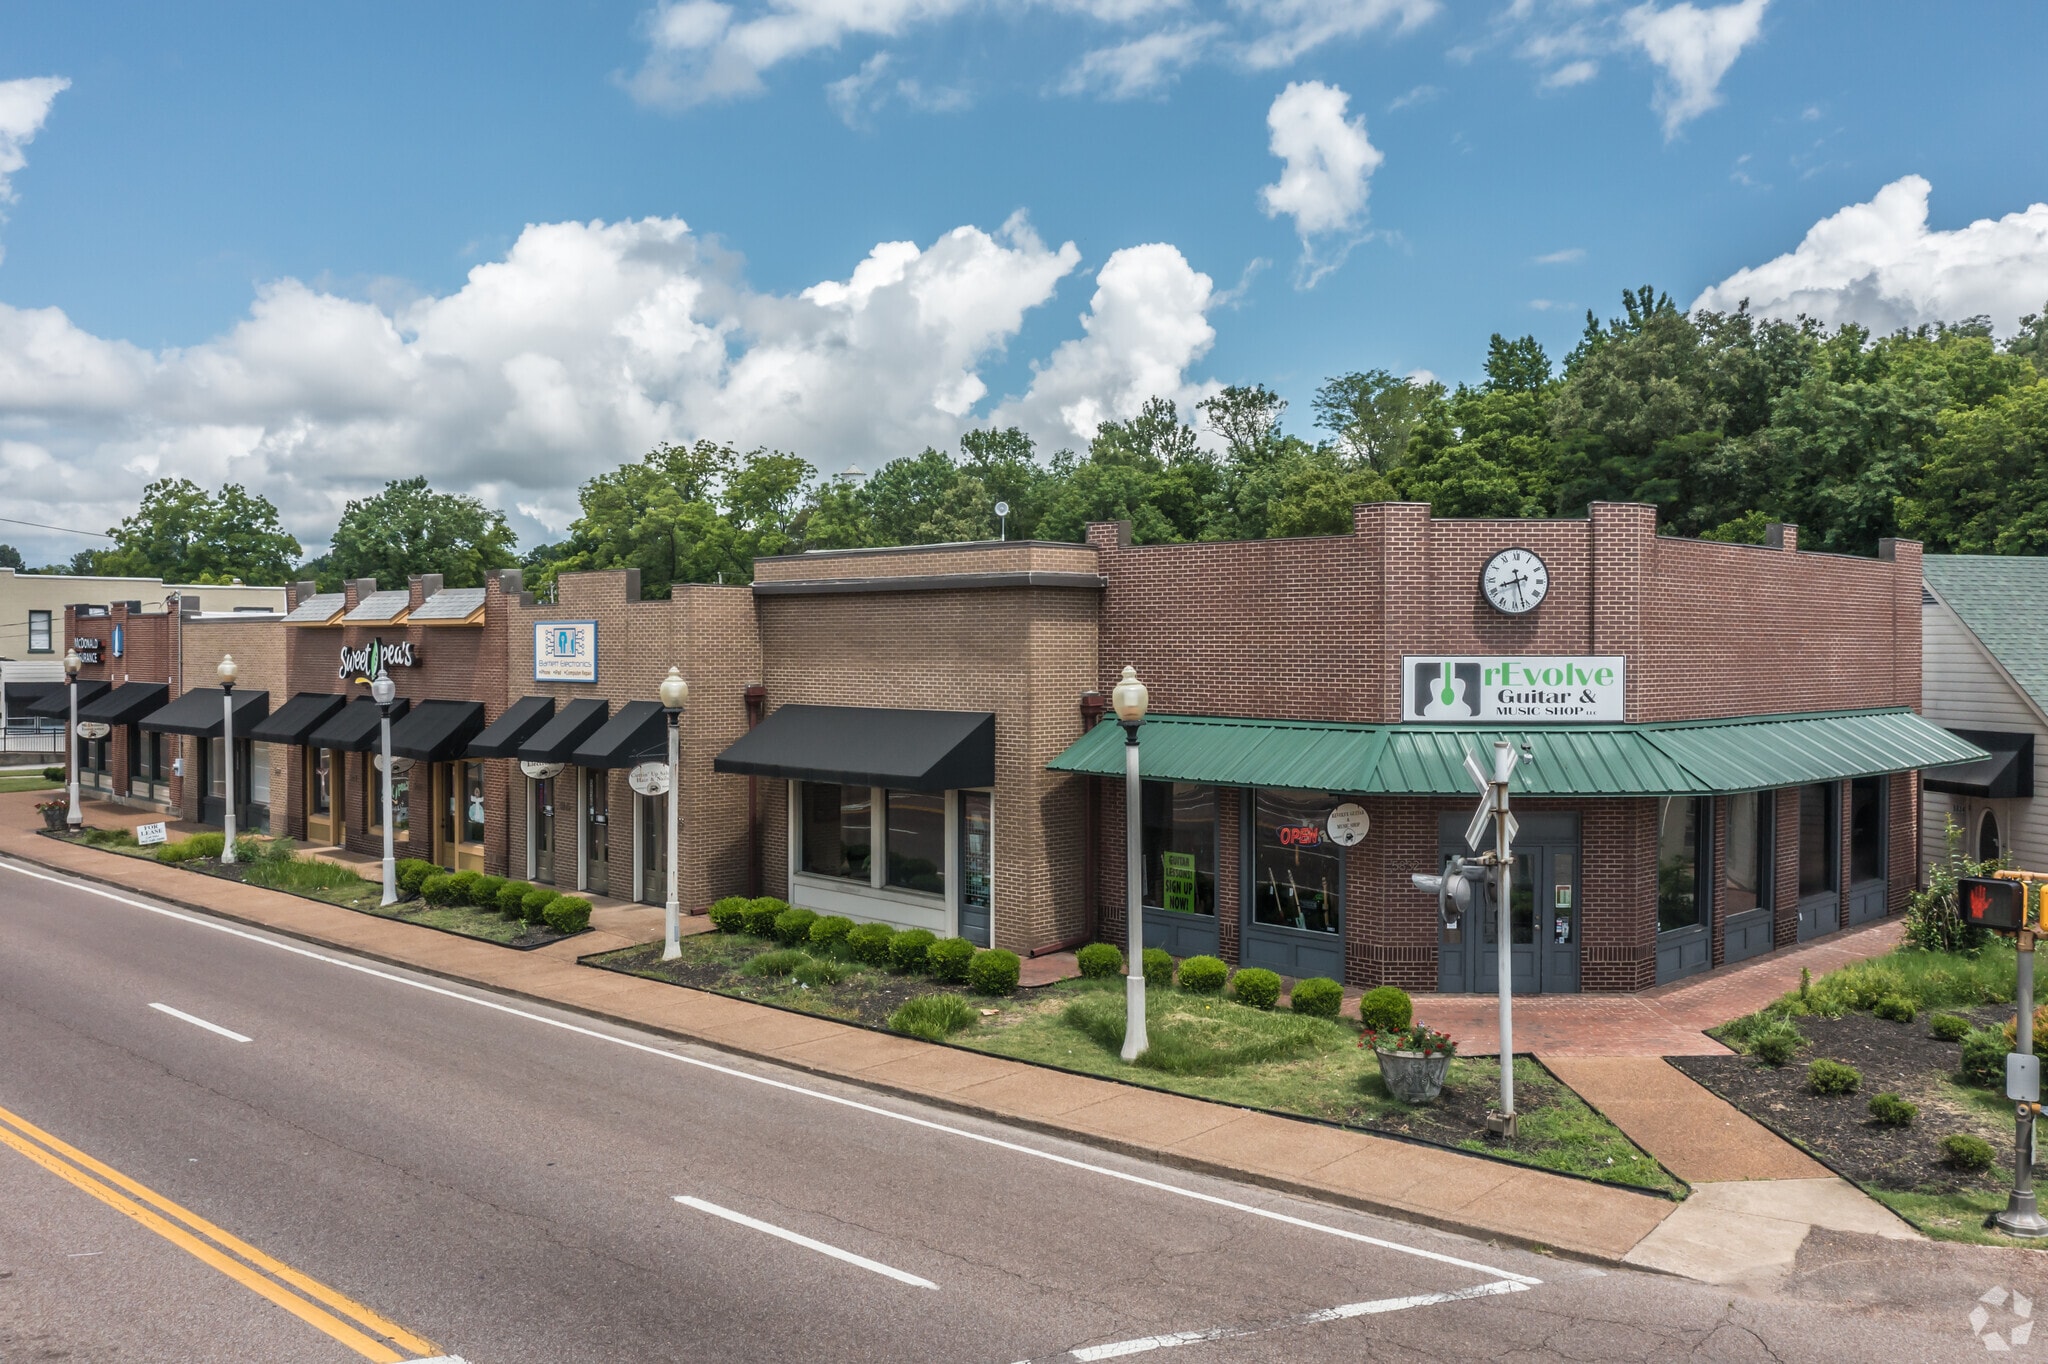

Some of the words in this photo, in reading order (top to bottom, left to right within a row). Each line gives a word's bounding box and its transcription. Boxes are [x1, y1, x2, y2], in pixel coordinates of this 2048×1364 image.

[339, 643, 371, 679] Sweet
[380, 641, 412, 671] pea's
[1484, 661, 1615, 687] rEvolve
[1498, 688, 1572, 704] Guitar
[1579, 688, 1596, 704] &
[1496, 706, 1541, 716] MUSIC
[1545, 706, 1584, 716] SHOP
[140, 828, 163, 837] LEASE
[144, 823, 159, 831] FOR
[1280, 826, 1319, 846] OPEN
[1165, 879, 1182, 895] SIGN
[1183, 881, 1193, 896] UP
[1169, 895, 1189, 911] NOW!
